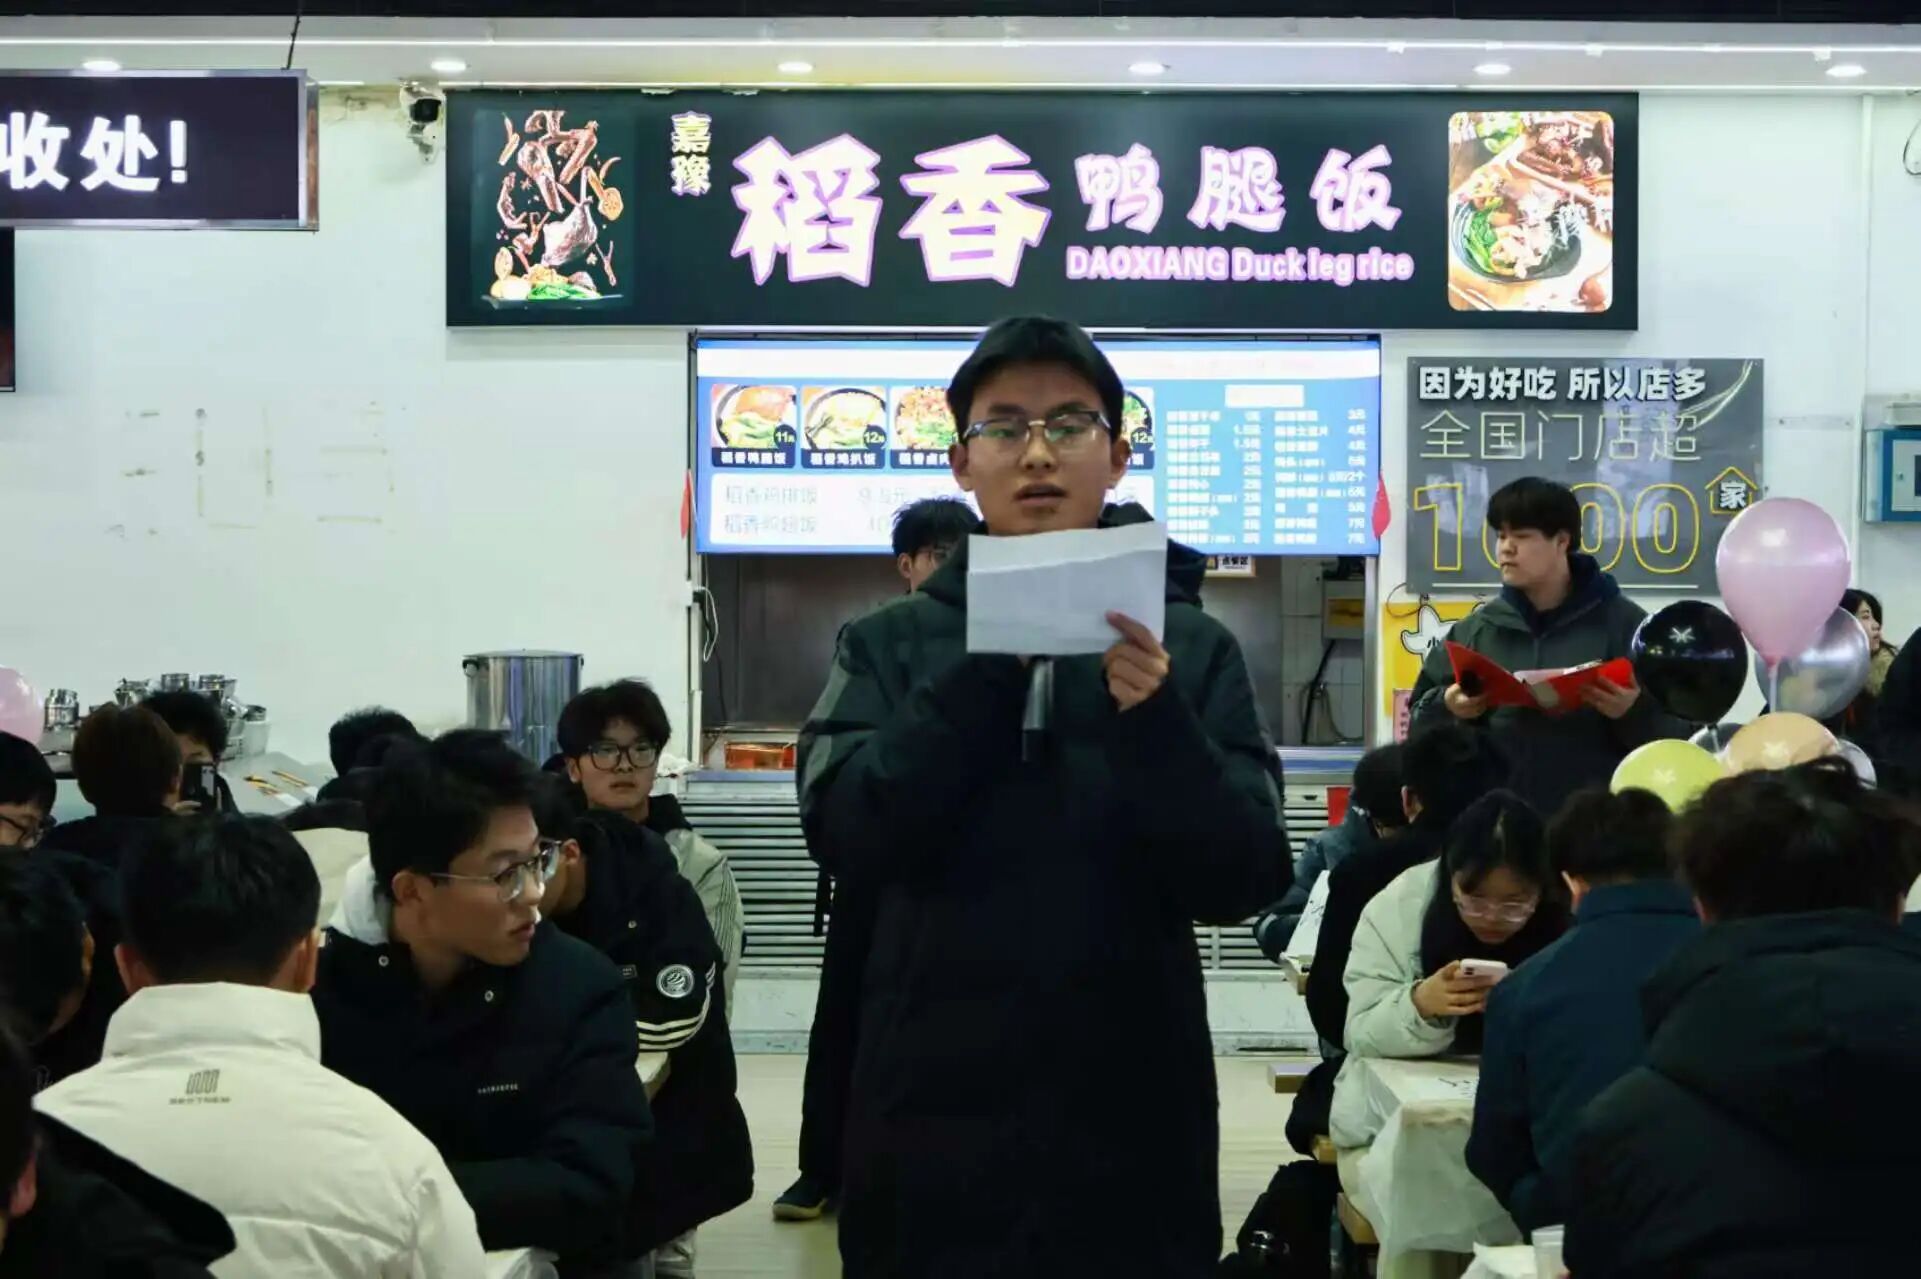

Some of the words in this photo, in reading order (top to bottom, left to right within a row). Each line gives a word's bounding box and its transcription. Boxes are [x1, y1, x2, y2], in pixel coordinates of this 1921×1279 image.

[1066, 246, 1227, 282] DAOXIANG
[1230, 246, 1304, 282] Duck
[1306, 247, 1353, 286] leg
[1355, 246, 1416, 282] rice
[1418, 366, 1557, 402] 因为好吃
[1566, 366, 1707, 402] 所以店多
[1419, 409, 1702, 462] 全国门店超
[1719, 481, 1747, 509] 家
[1413, 482, 1700, 574] 100
